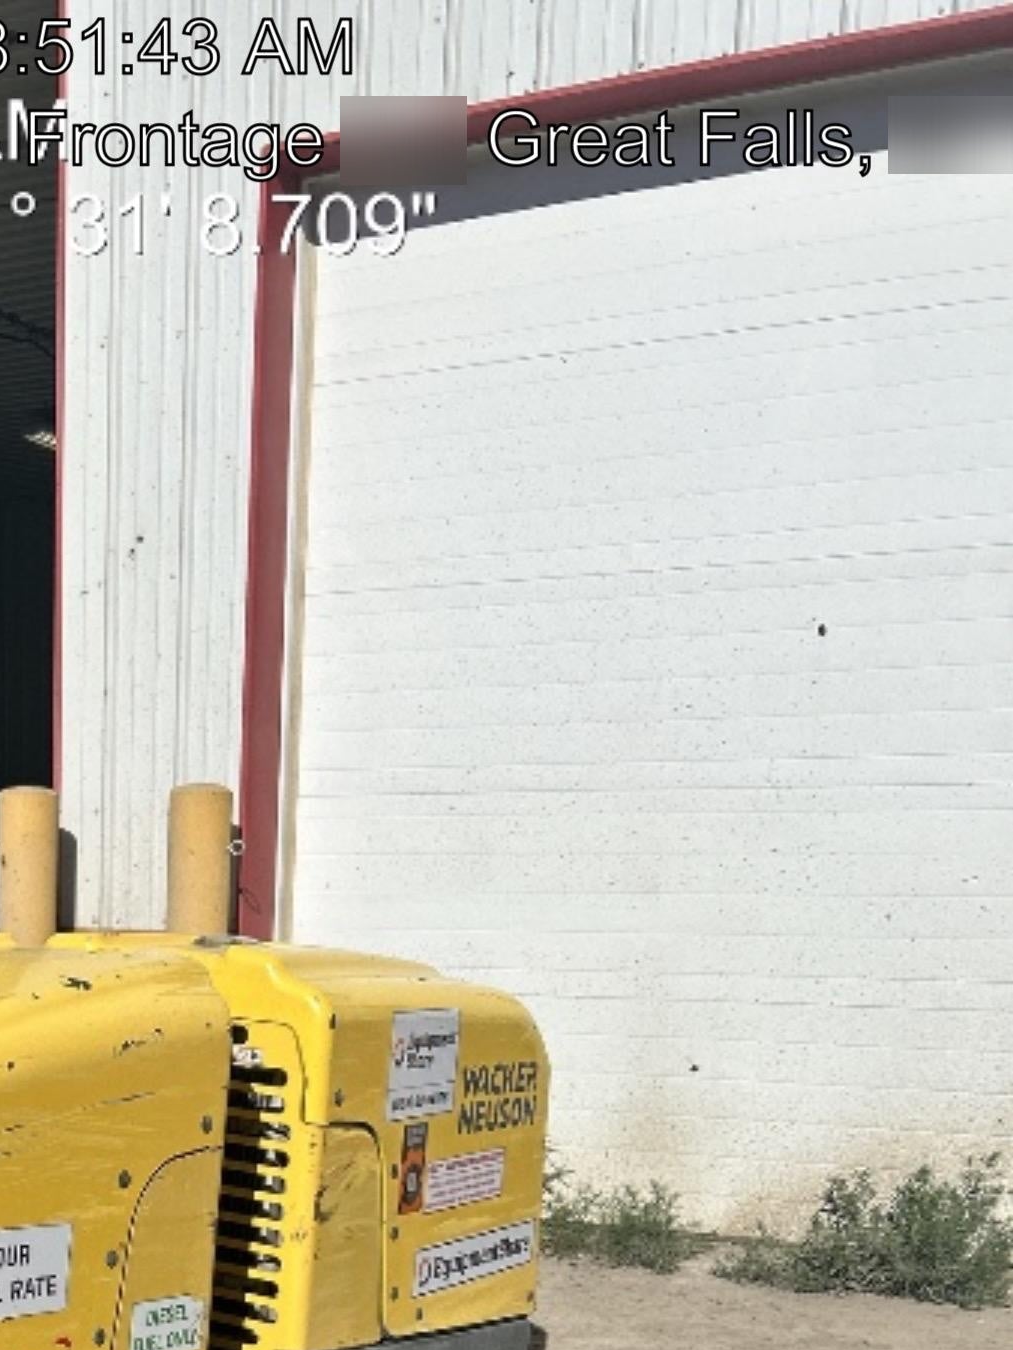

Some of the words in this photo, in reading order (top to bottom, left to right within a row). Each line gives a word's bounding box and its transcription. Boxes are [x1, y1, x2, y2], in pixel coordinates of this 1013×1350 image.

[463, 1061, 538, 1099] WACKER
[458, 1095, 538, 1135] NEUSON
[9, 1273, 58, 1301] RATE
